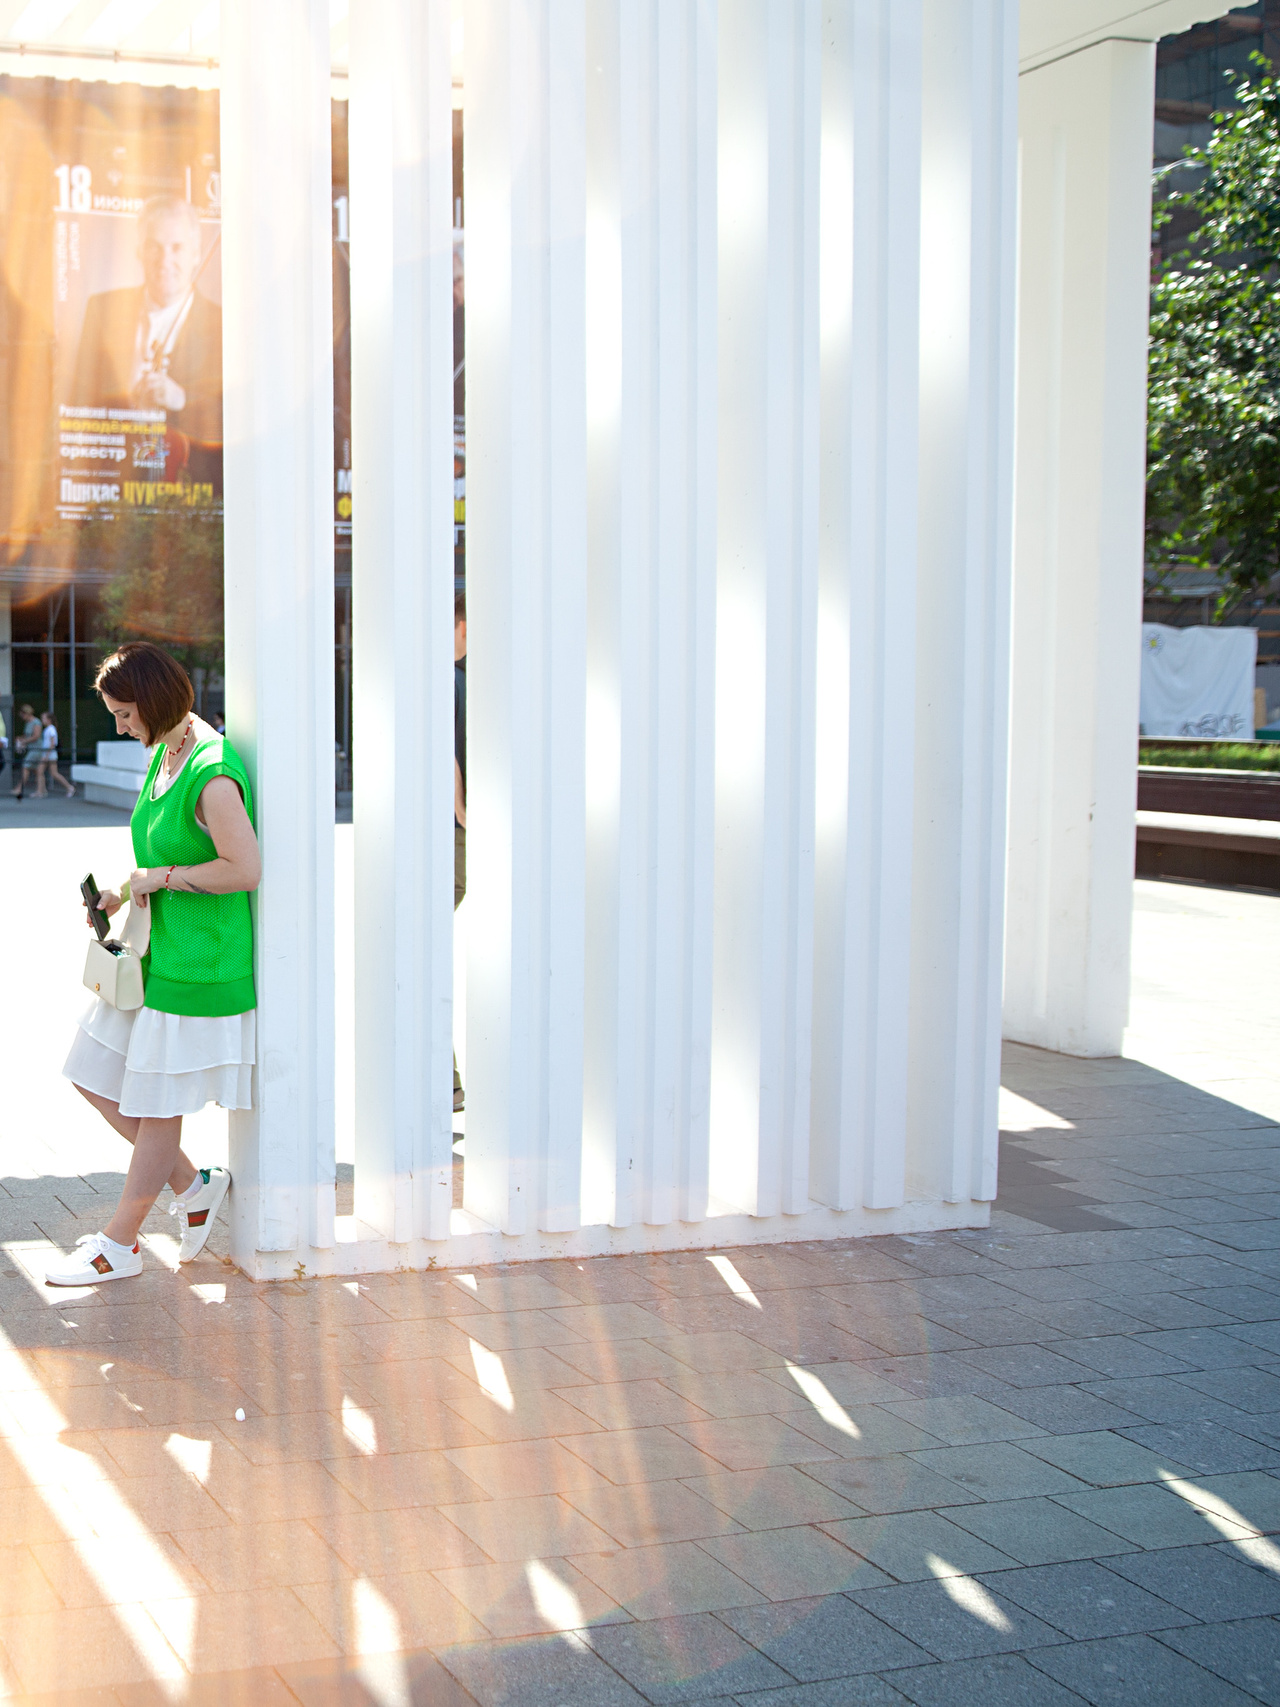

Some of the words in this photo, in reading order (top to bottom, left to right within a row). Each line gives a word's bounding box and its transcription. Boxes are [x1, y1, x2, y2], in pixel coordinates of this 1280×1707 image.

[54, 164, 92, 212] 18
[59, 418, 167, 434] молодёжный
[60, 445, 127, 462] оркестр
[60, 477, 120, 503] Пинхас
